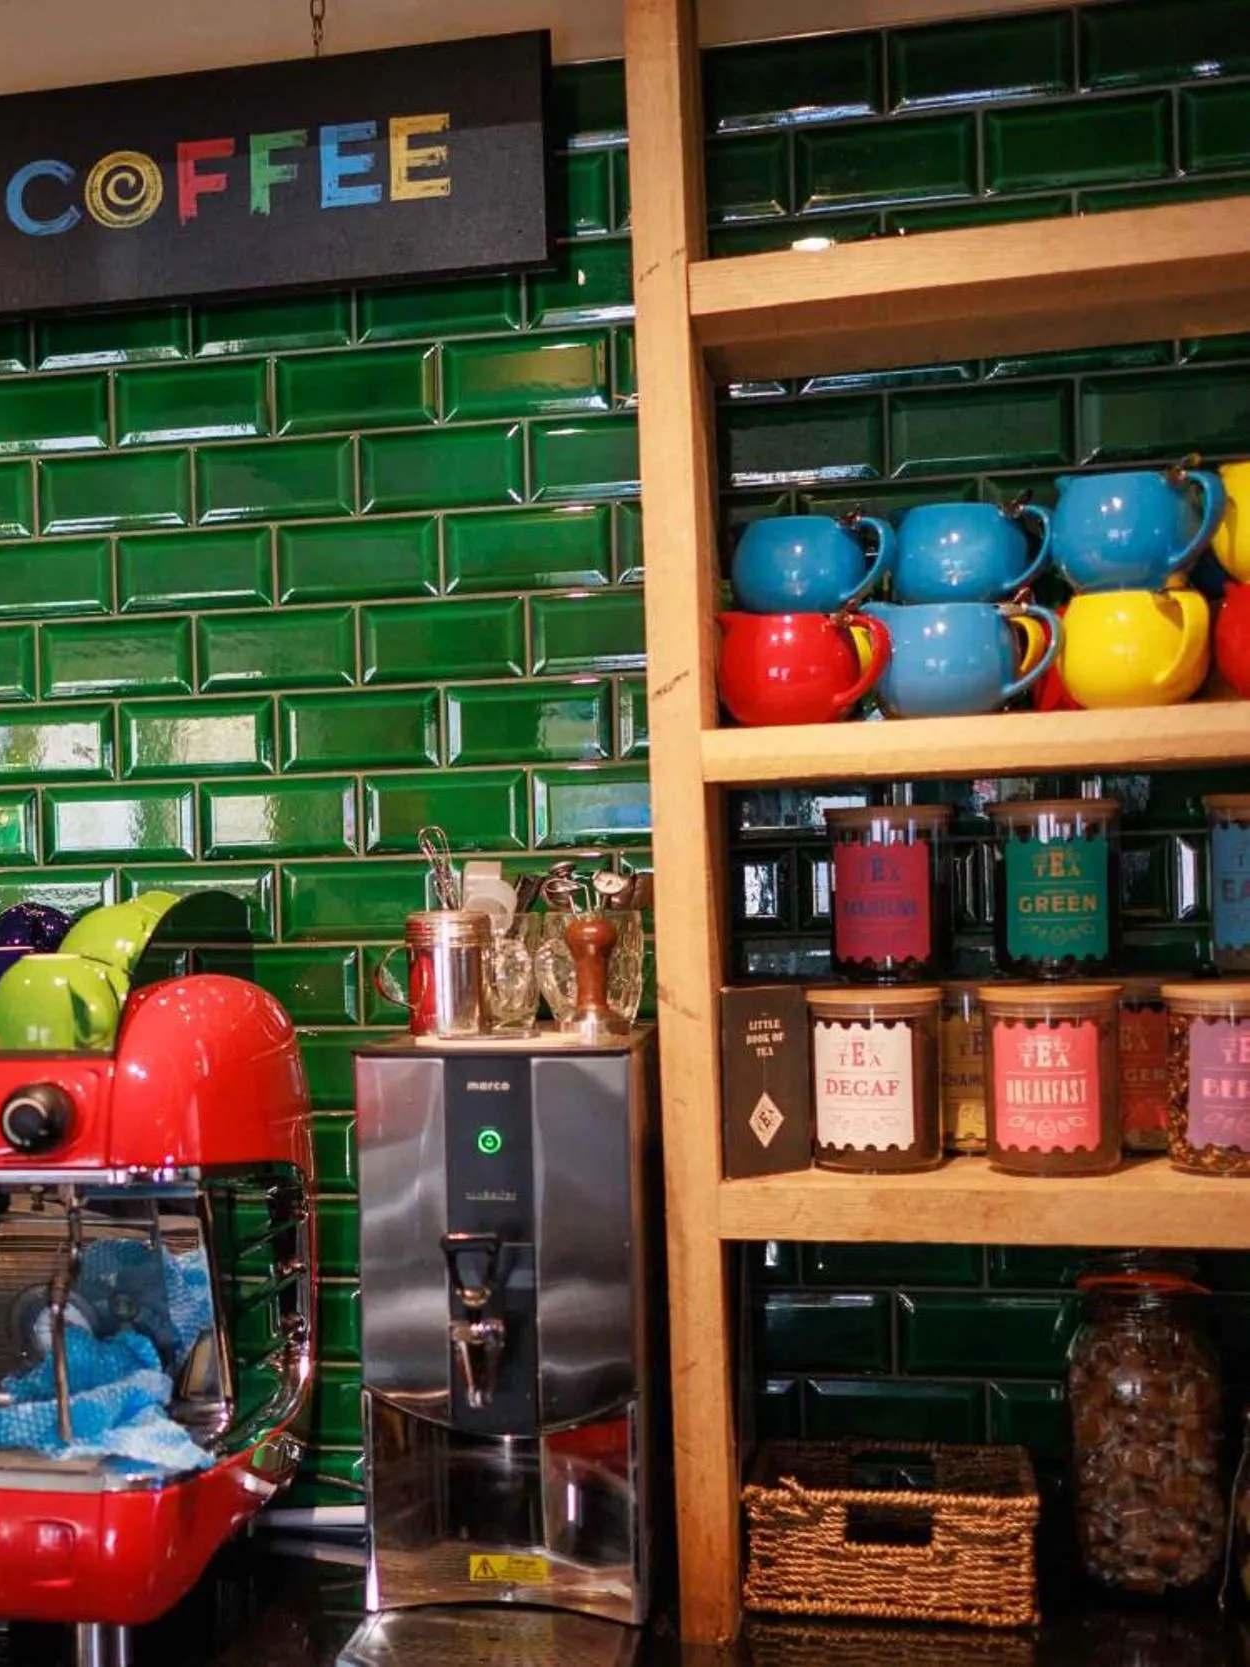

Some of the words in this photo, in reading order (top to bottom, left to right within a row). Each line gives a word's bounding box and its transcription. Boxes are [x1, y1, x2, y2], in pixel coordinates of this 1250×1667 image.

[6, 112, 451, 236] COFFEE
[1033, 851, 1081, 878] TEA
[1018, 895, 1098, 913] GREEN
[748, 1019, 781, 1031] LITTLE
[746, 1034, 770, 1045] BOOK
[771, 1032, 784, 1043] OF
[958, 1031, 983, 1056] TE
[756, 1046, 774, 1057] TEA
[839, 1042, 882, 1067] TEA
[1020, 1040, 1070, 1067] TEA
[466, 1081, 511, 1091] marco
[825, 1078, 900, 1097] DECAF
[1005, 1079, 1087, 1105] BREAKFAST
